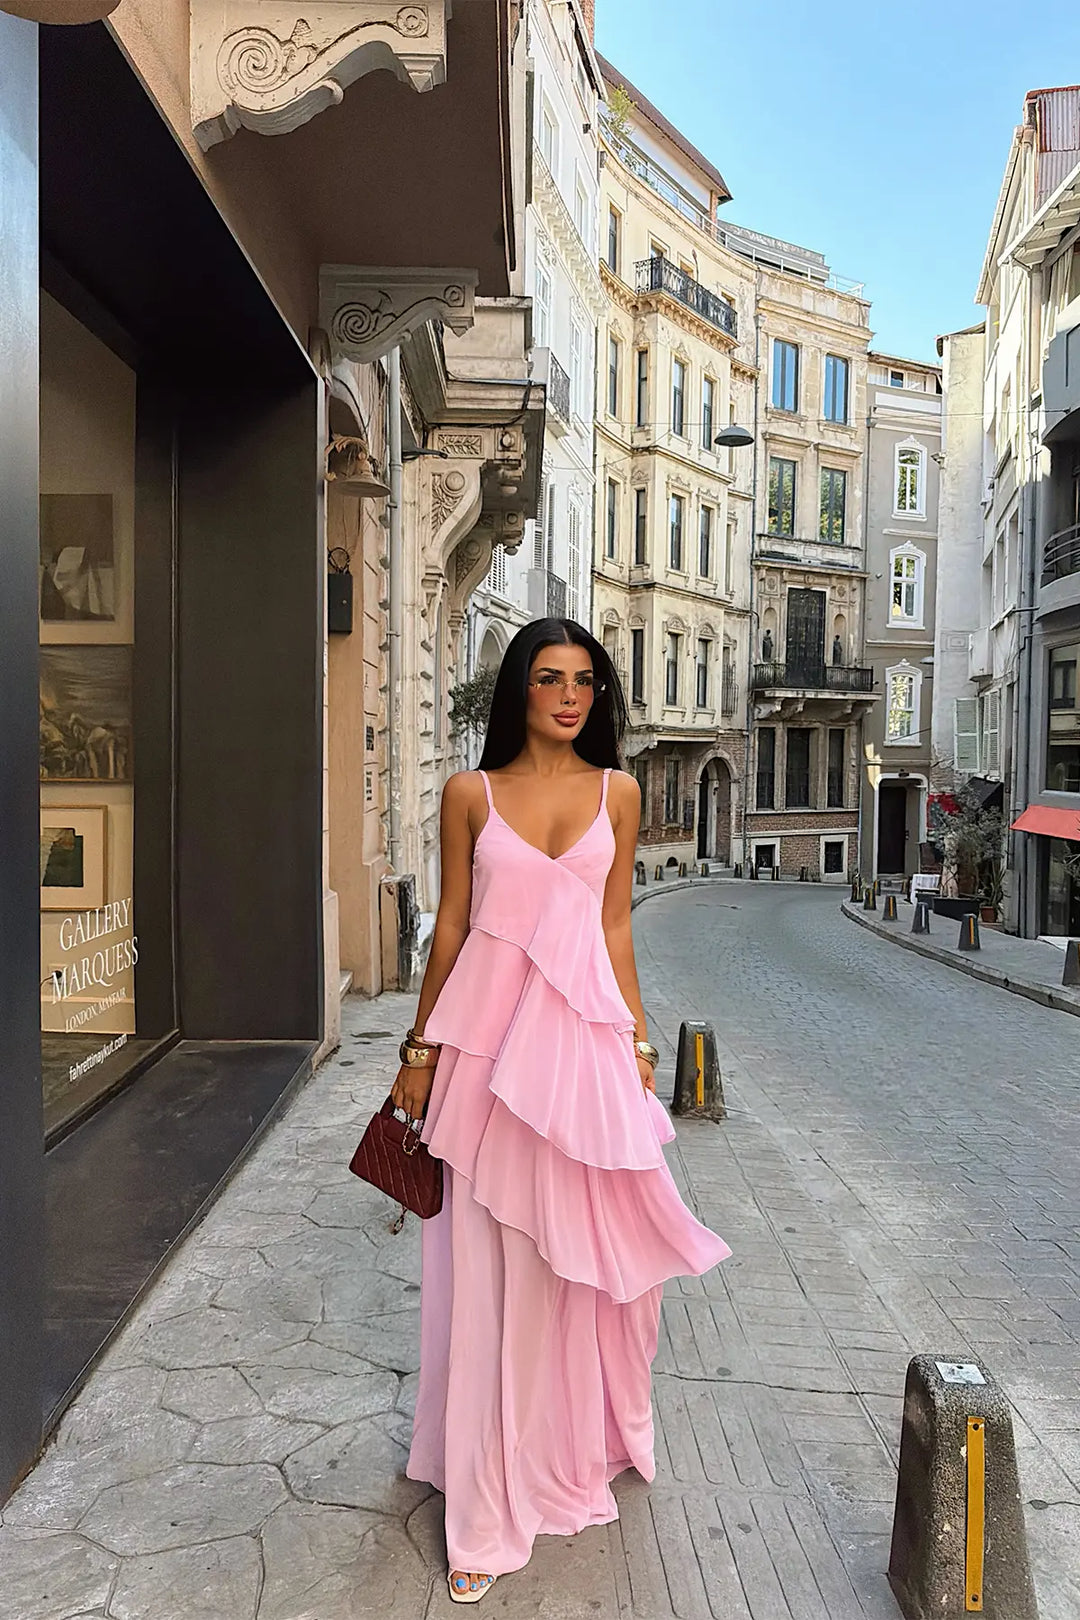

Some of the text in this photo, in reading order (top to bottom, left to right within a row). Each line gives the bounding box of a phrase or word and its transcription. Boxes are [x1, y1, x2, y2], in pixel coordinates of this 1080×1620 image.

[59, 898, 132, 951] GALLERY
[51, 936, 138, 1004] MARQUESS
[65, 1004, 98, 1033] LONDON
[69, 1033, 127, 1082] fahrettinaykut.com
